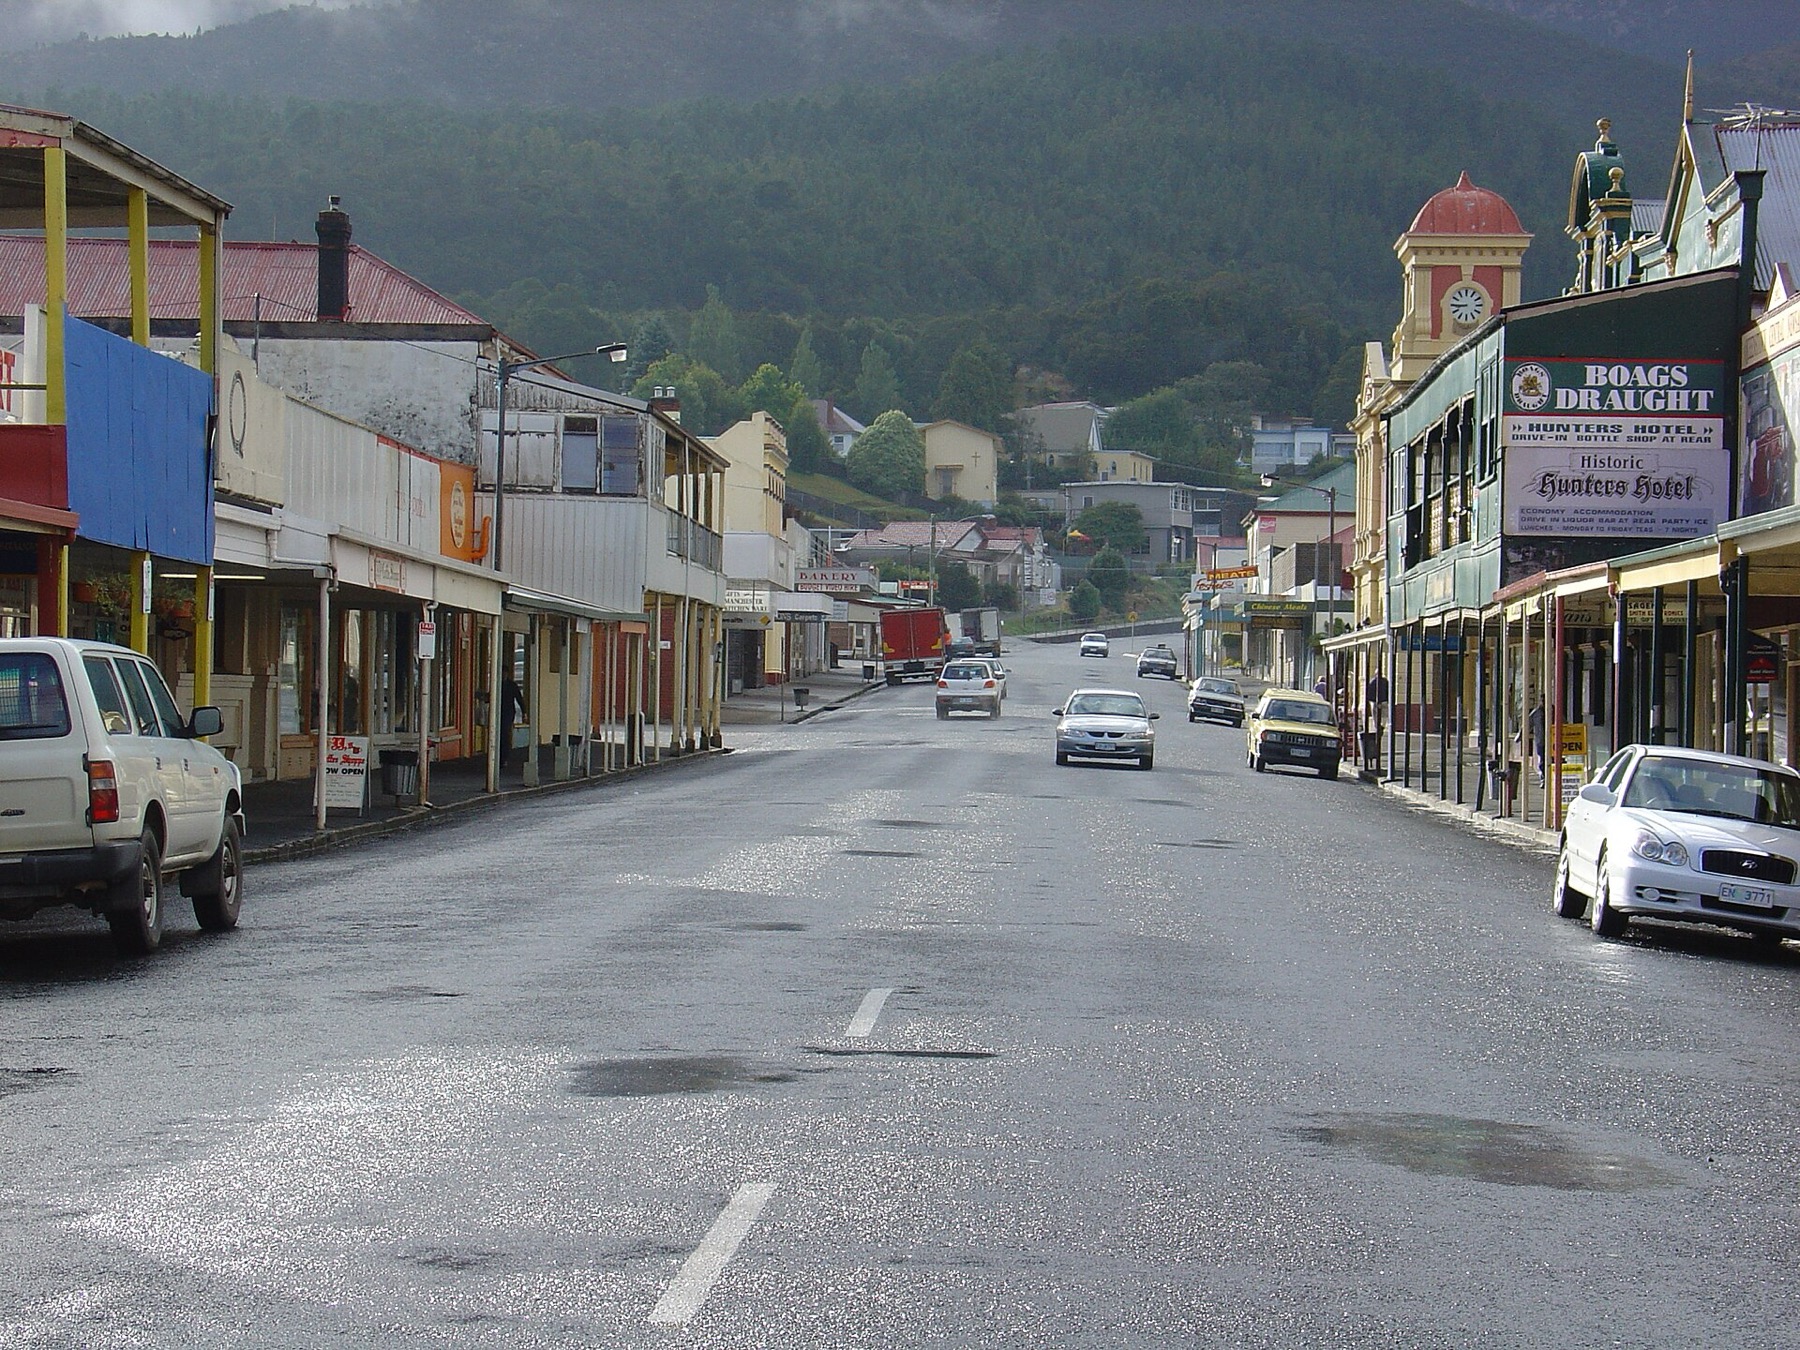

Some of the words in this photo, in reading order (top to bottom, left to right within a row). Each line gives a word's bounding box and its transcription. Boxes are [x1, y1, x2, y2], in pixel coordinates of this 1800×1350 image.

[1584, 365, 1688, 387] BOAGS
[1554, 388, 1714, 411] DRAUGHT
[1528, 423, 1623, 434] HUNTERS
[1634, 425, 1697, 435] HOTEL
[1626, 435, 1657, 443] SHOP
[1581, 455, 1644, 470] Historic
[1537, 472, 1629, 502] Hunters
[1632, 475, 1694, 504] Hotel
[800, 572, 857, 581] BAKERY
[1208, 570, 1256, 580] MEATS
[1251, 603, 1280, 611] Chinese
[1553, 742, 1583, 752] PEN
[341, 767, 365, 775] OPEN
[1744, 890, 1771, 904] 3771
